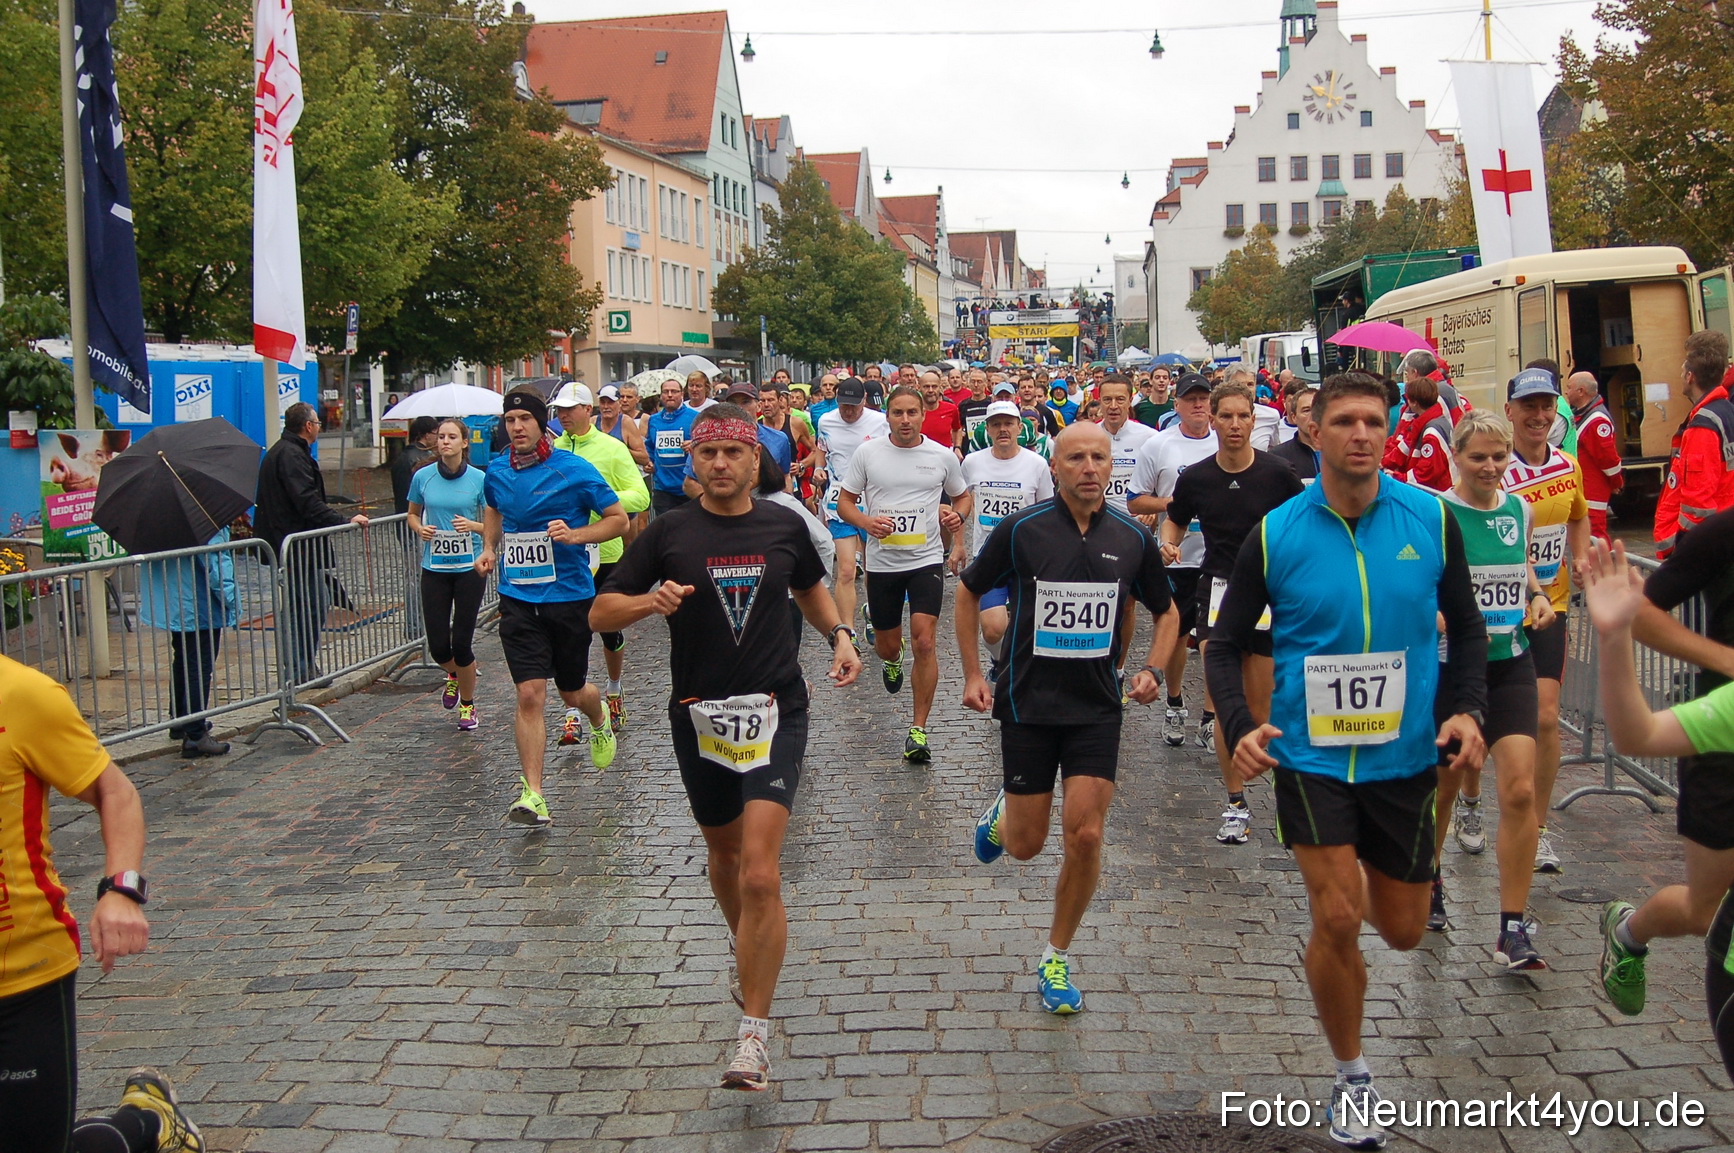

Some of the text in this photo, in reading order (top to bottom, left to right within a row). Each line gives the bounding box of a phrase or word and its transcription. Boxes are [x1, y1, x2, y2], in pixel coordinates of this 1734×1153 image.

[612, 313, 628, 330] D
[1442, 307, 1492, 335] Bayerisches
[1018, 327, 1049, 336] START
[1442, 337, 1465, 356] Rotes
[1449, 363, 1465, 378] euz
[658, 437, 681, 448] 2969
[51, 504, 75, 516] BEIDE
[982, 498, 1020, 516] 2435
[87, 532, 109, 544] UND
[1532, 530, 1560, 539] Neumarkt
[434, 538, 468, 554] 2961
[507, 544, 548, 565] 3040
[706, 554, 766, 566] FINISHER
[712, 566, 762, 578] BRAVEHEART
[1488, 572, 1519, 580] Neumarkt
[721, 579, 754, 588] BATTLE
[1038, 588, 1104, 598] PARTL Neumarkt
[1043, 601, 1110, 629] 2540
[1485, 613, 1506, 624] eike
[1055, 635, 1095, 648] Herbert
[1307, 662, 1389, 674] PARTL Neumarkt
[1327, 675, 1387, 710] 167
[708, 713, 762, 743] 518
[1333, 718, 1386, 733] Maurice
[713, 740, 756, 764] Wolfgang
[9, 1068, 38, 1080] asics
